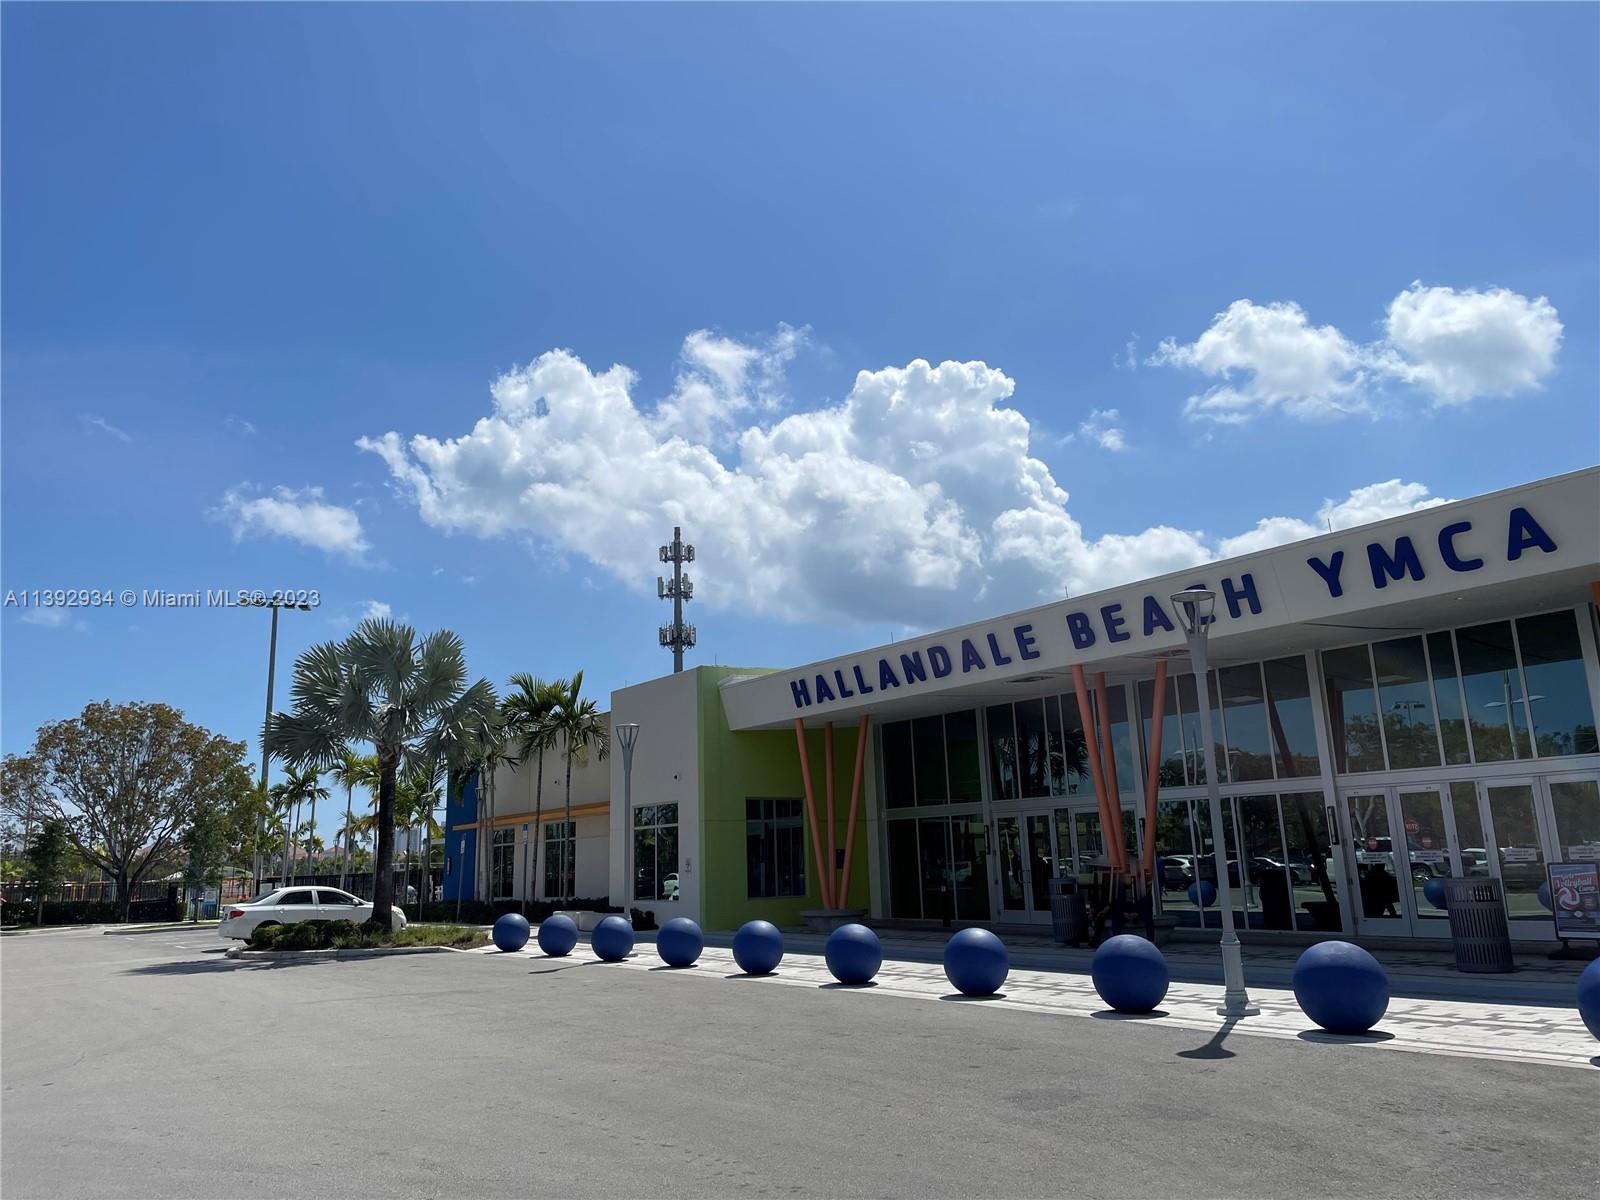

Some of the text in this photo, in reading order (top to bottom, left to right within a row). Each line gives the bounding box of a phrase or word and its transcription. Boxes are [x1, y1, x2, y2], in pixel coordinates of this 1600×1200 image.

[790, 507, 1558, 709] HALLANDALE BEACH YMCA
